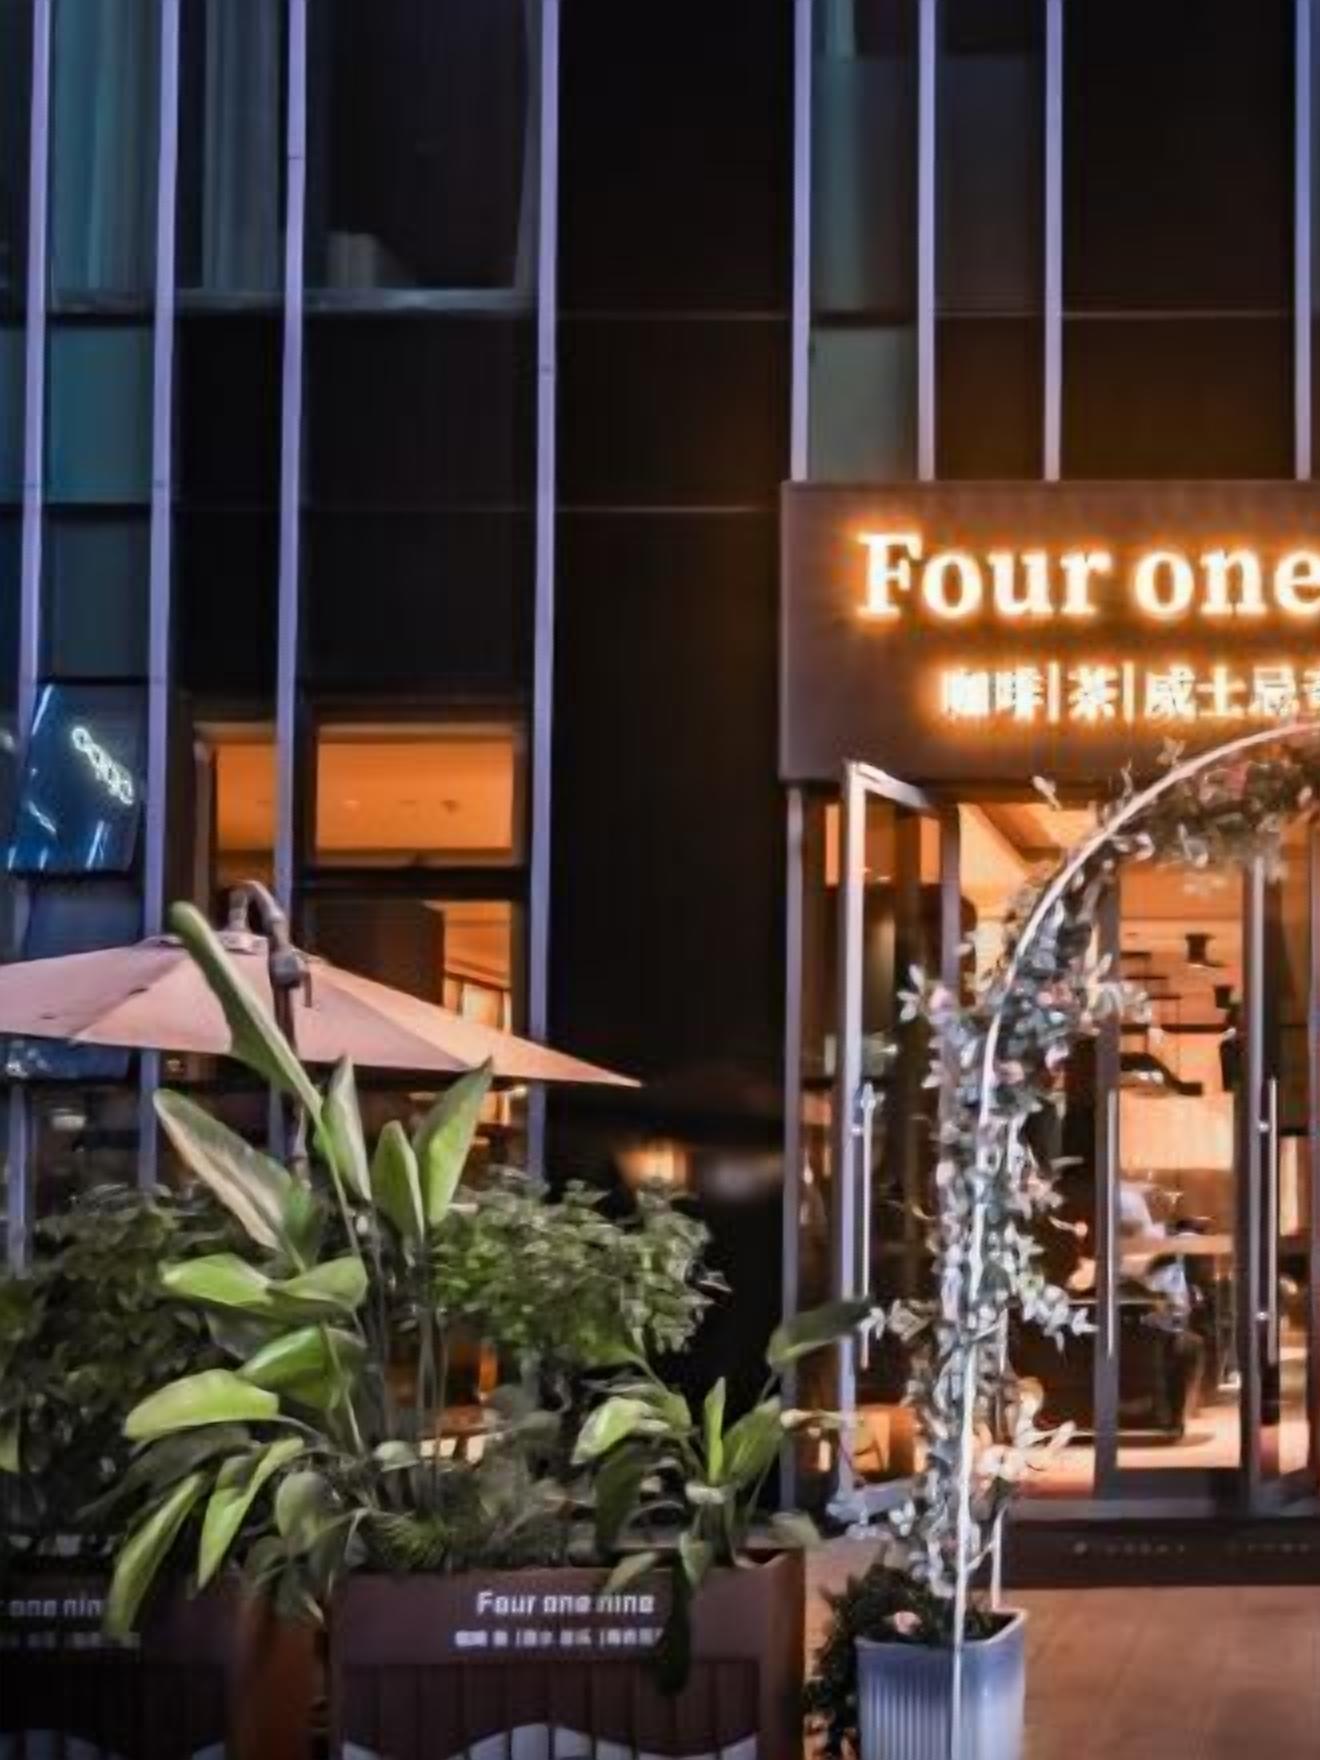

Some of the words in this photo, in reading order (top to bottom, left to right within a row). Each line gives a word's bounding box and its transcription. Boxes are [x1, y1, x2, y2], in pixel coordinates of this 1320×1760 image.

[858, 531, 1110, 620] Four
[476, 1590, 537, 1617] Four
[543, 1594, 592, 1613] one
